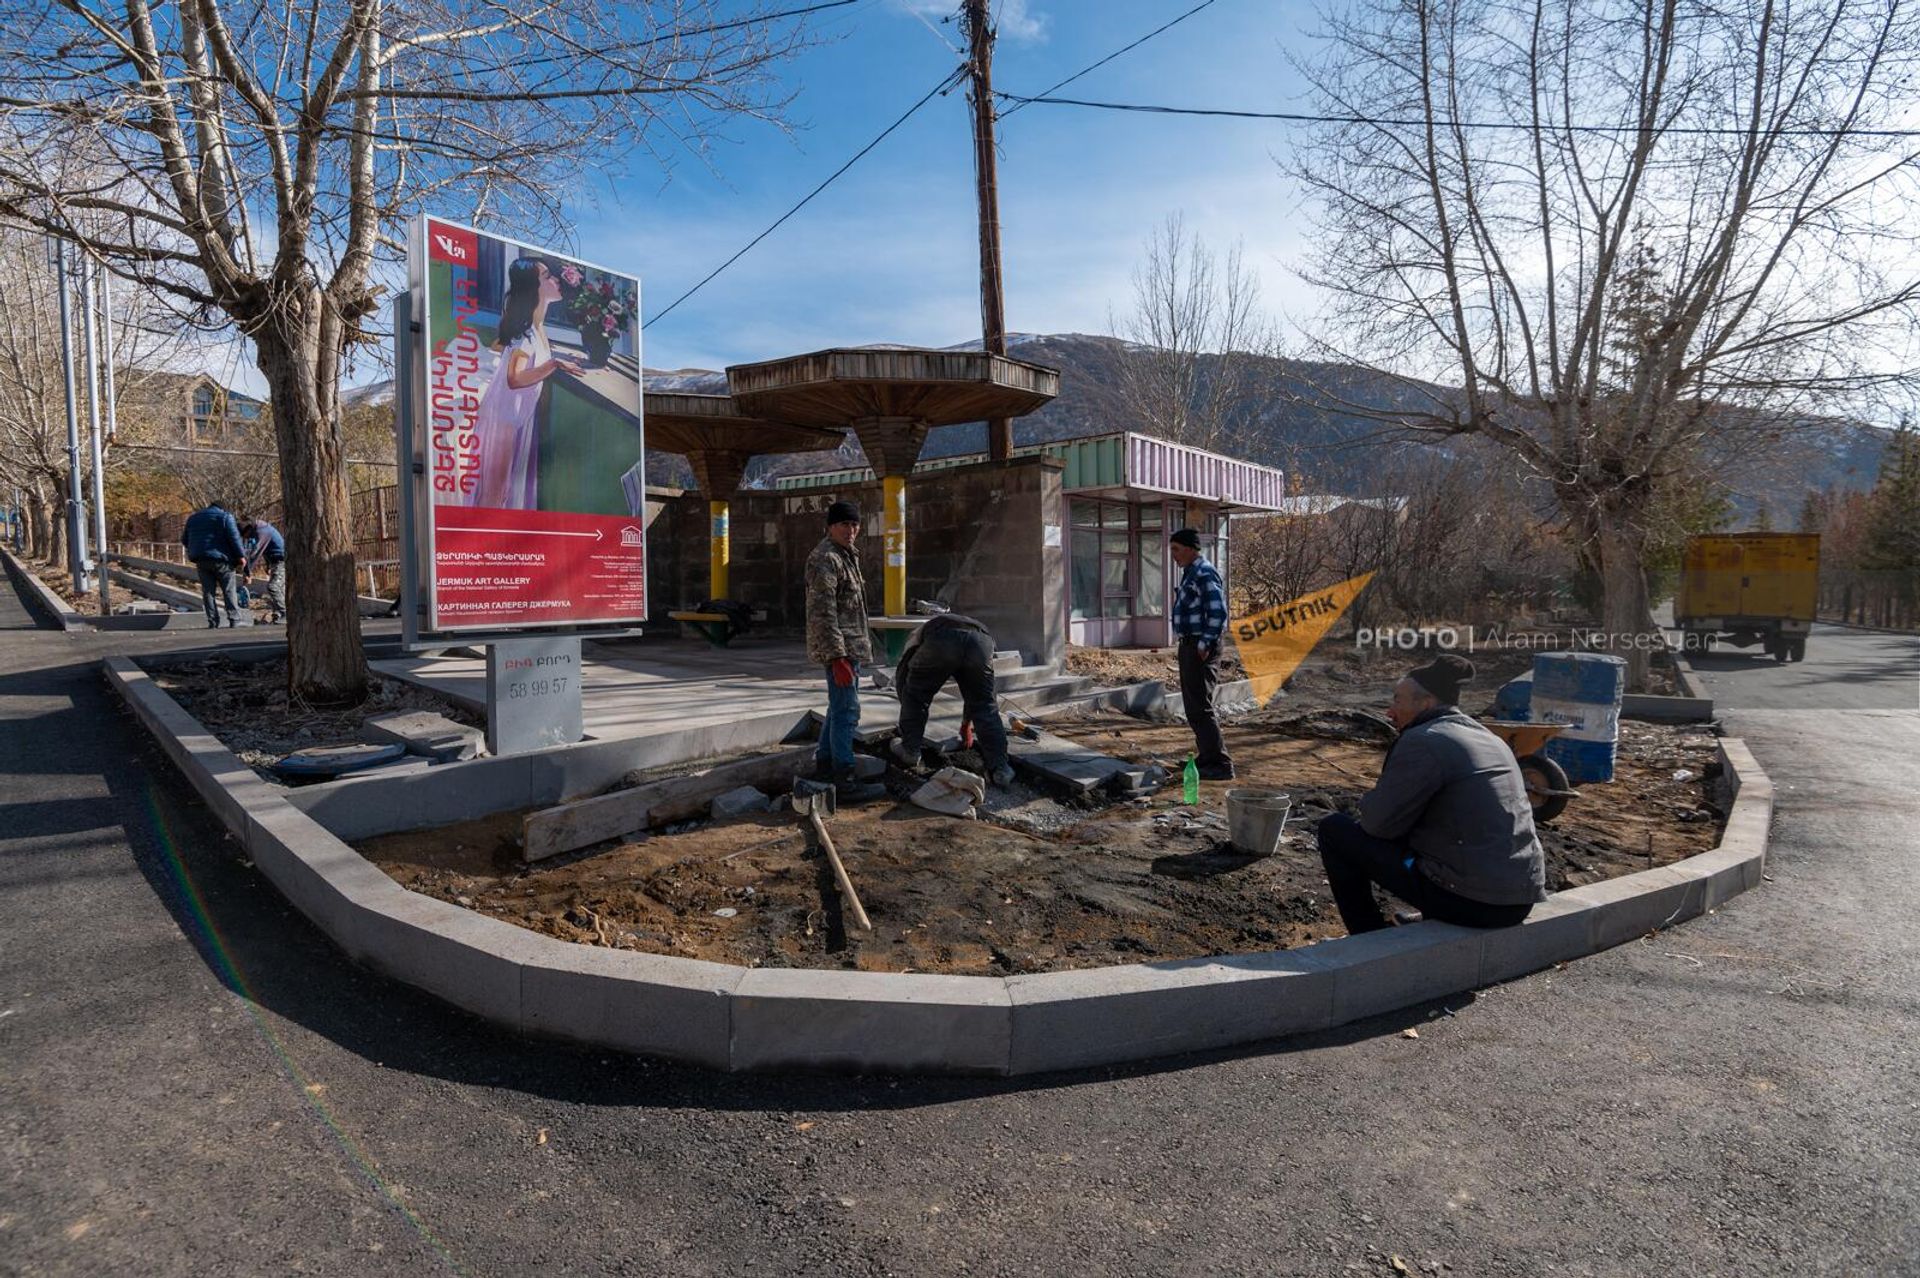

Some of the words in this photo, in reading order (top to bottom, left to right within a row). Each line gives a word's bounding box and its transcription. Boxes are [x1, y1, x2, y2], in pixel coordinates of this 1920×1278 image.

[436, 577, 473, 586] JERMUK
[474, 577, 491, 586] ART
[493, 577, 531, 585] GALLERY
[437, 602, 490, 611] КАРТИННАЯ
[491, 601, 528, 609] ГАЛЕРЕЯ
[529, 600, 571, 609] ДЖЕРМУКА
[510, 682, 527, 699] 58
[531, 680, 549, 696] 99
[553, 677, 568, 694] 57
